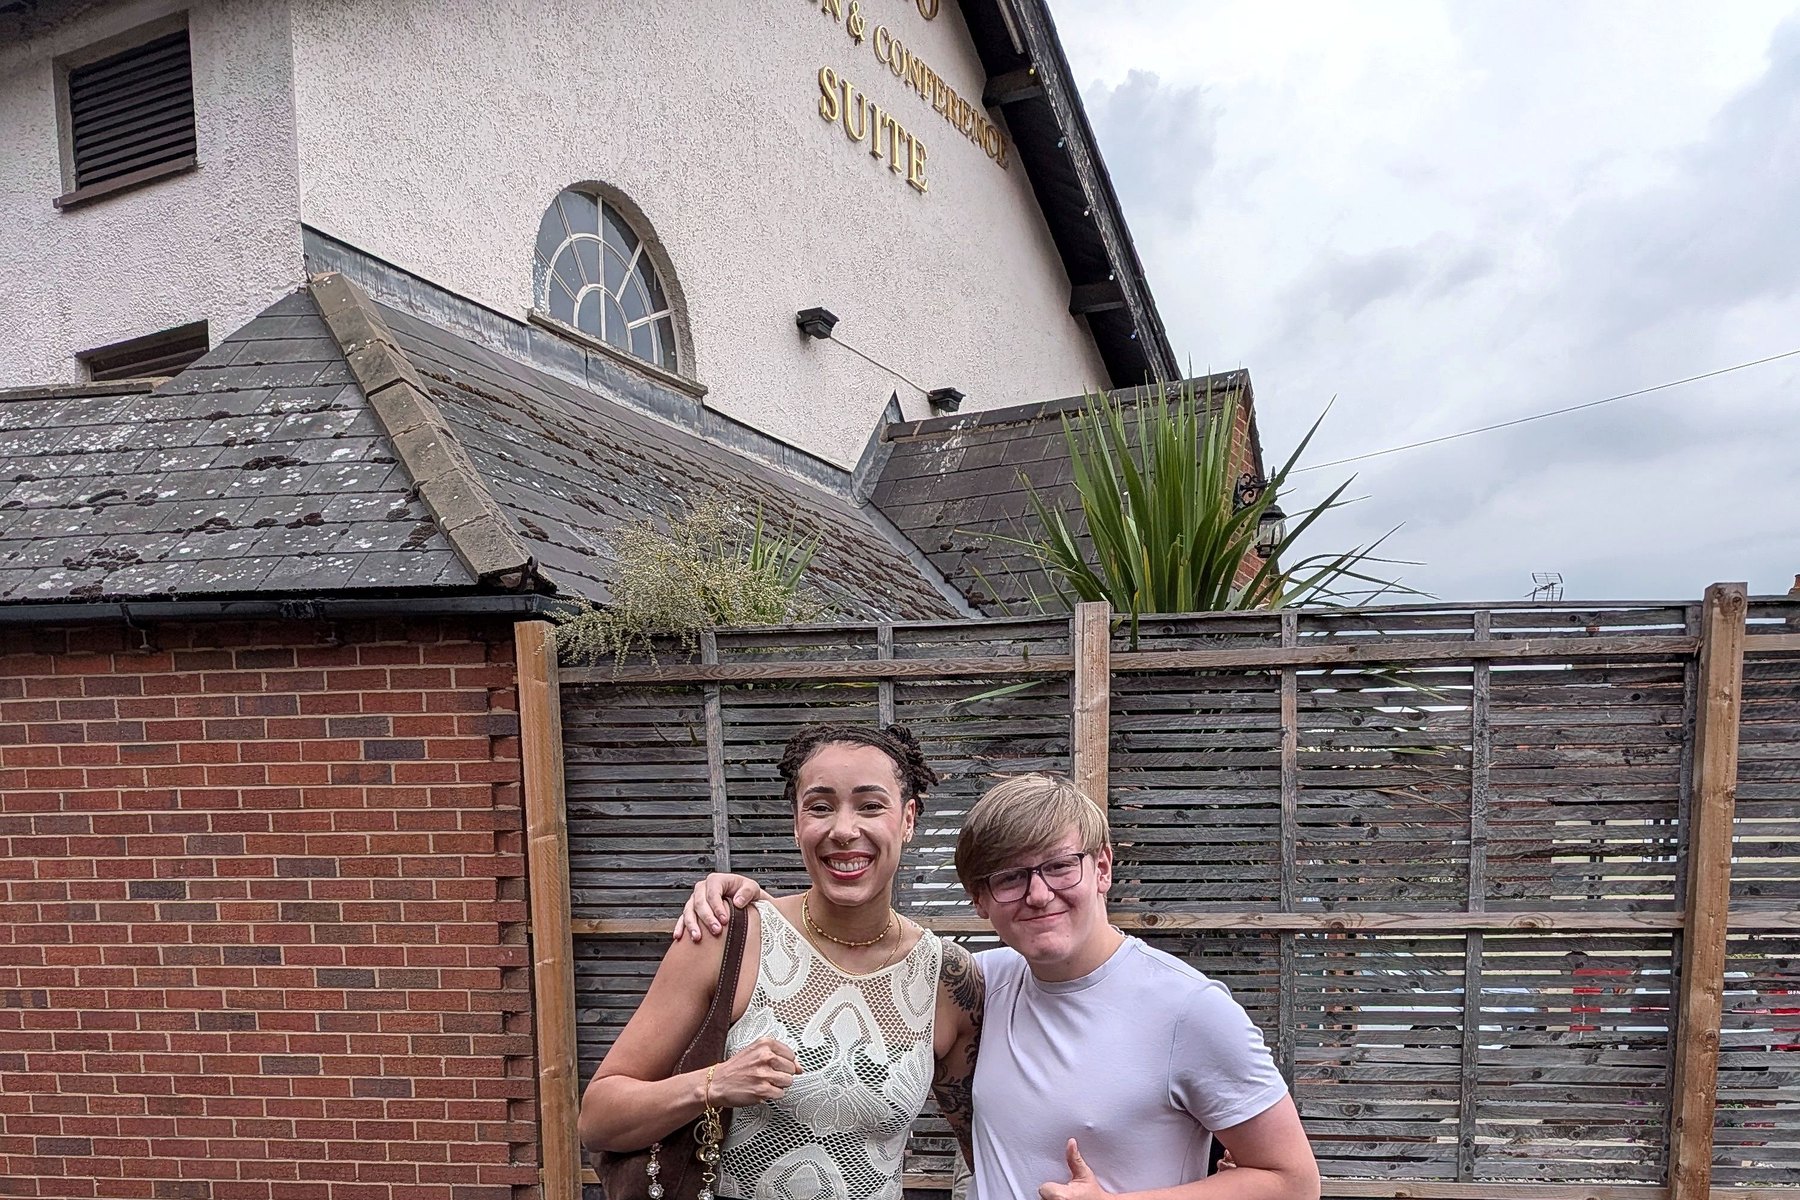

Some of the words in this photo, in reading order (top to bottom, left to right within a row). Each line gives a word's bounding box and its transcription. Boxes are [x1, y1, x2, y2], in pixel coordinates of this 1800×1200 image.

[819, 65, 929, 192] SUITE
[848, 1, 865, 43] &
[874, 25, 1009, 169] CONFERENCE
